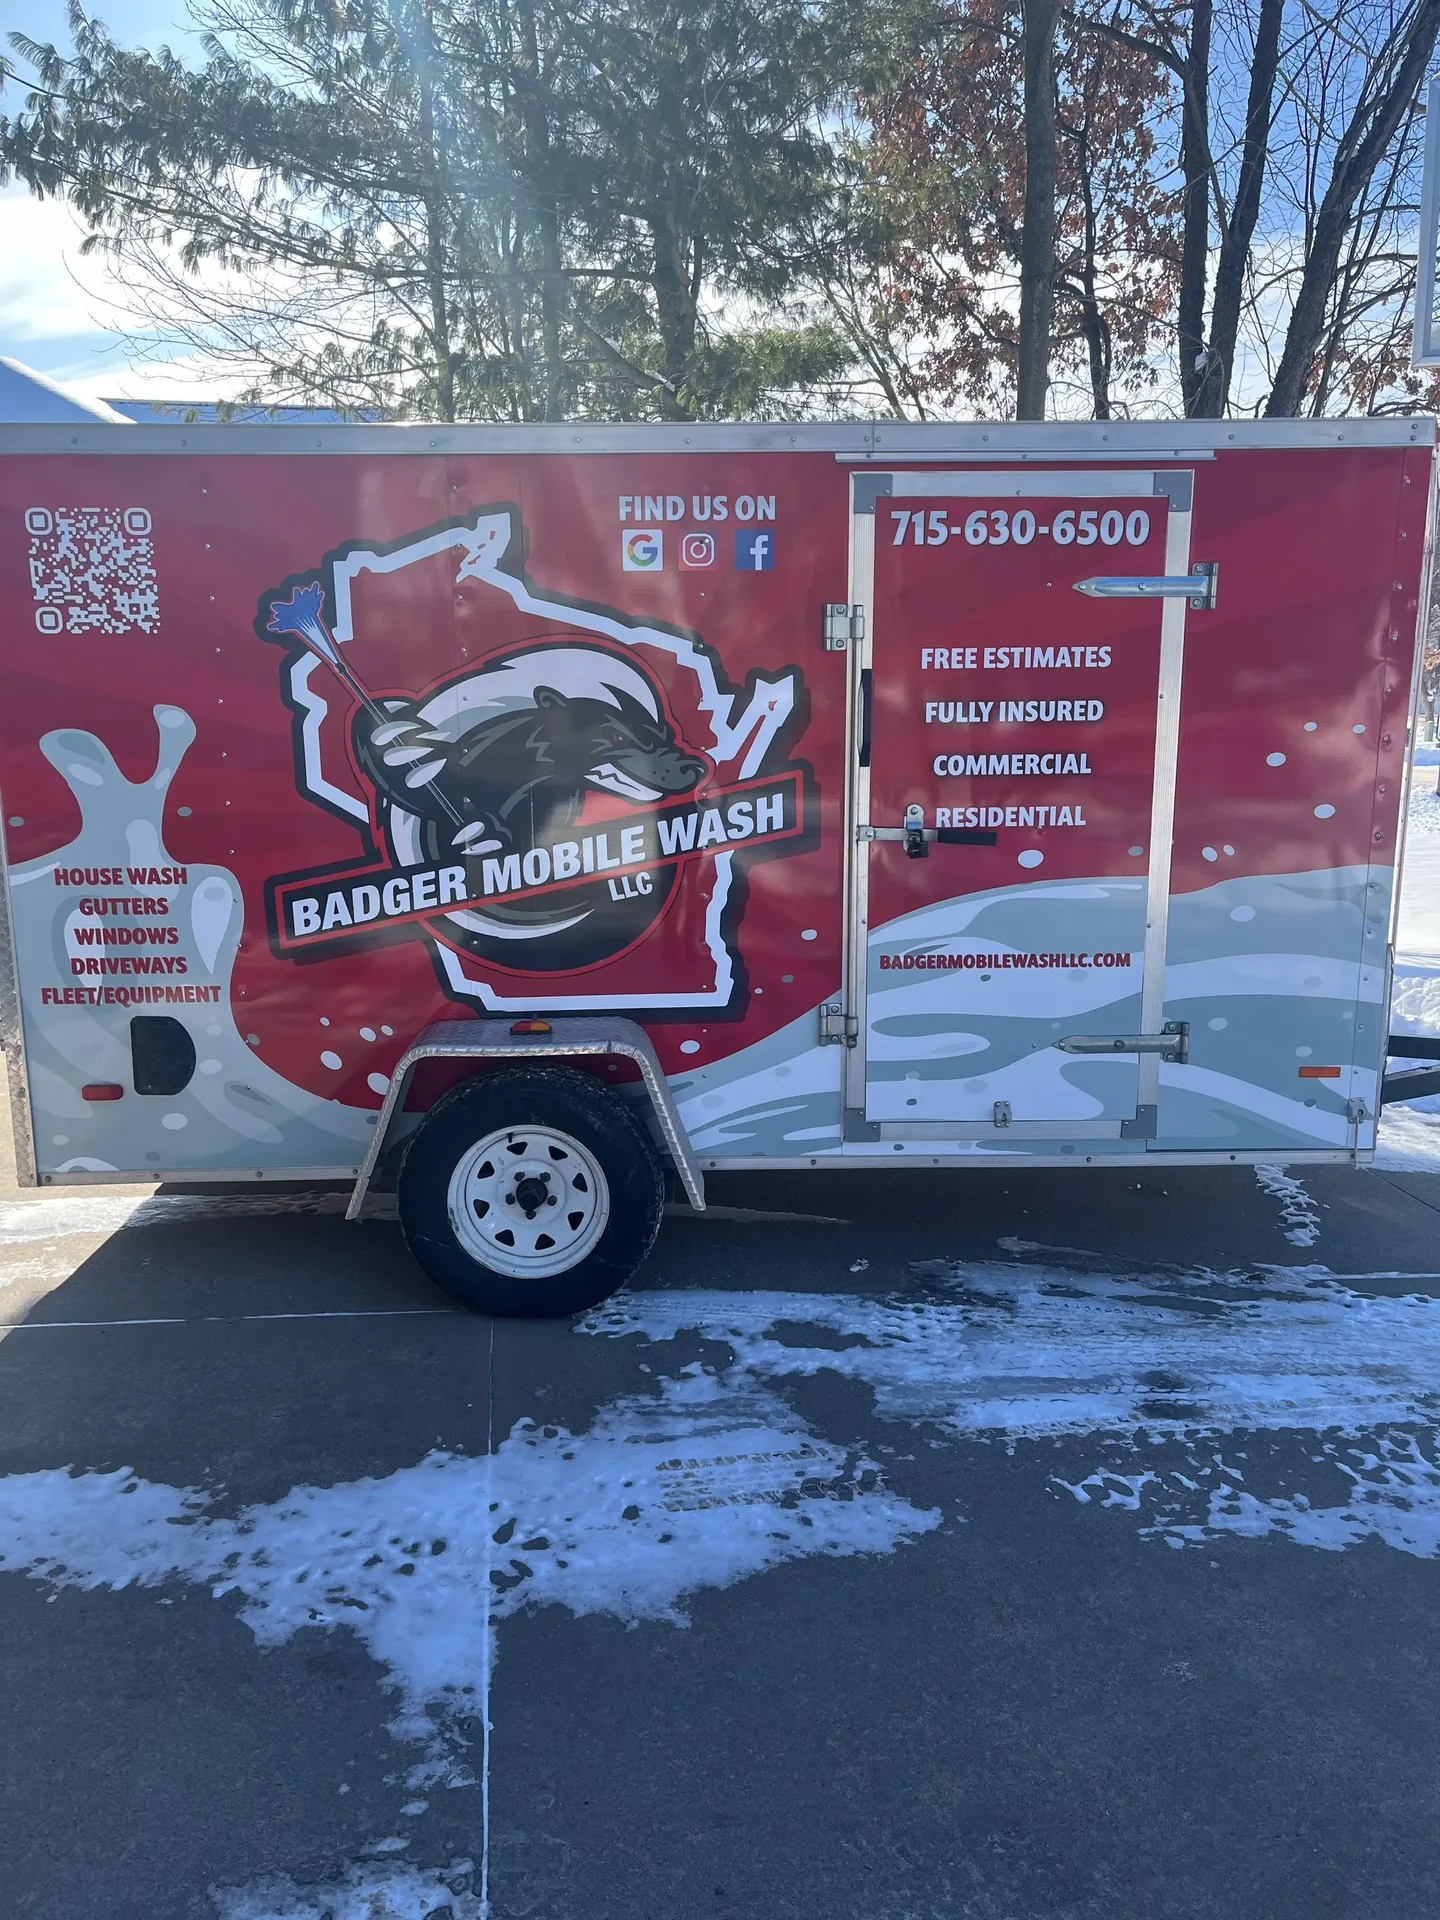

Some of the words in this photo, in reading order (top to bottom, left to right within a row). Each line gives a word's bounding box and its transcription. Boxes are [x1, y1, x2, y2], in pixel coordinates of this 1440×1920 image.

[618, 496, 686, 522] FIND
[692, 495, 728, 521] US
[735, 495, 776, 521] ON
[891, 509, 1151, 546] 715-630-6500
[627, 534, 659, 567] G
[921, 647, 977, 670] FREE
[983, 646, 1112, 669] ESTIMATES
[925, 701, 994, 724] FULLY
[999, 700, 1104, 723] INSURED
[933, 753, 1092, 776] COMMERCIAL
[935, 805, 1087, 829] RESIDENTIAL
[291, 865, 468, 936] BADGER
[482, 825, 646, 895] MOBILE
[657, 792, 785, 856] WASH
[54, 868, 124, 886] HOUSE
[126, 867, 188, 885] WASH
[608, 871, 653, 902] LLC
[79, 897, 169, 916] GUTTERS
[74, 927, 179, 945] WINDOWS
[70, 957, 188, 975] DRIVEWAYS
[880, 953, 1131, 970] BADGERMOBILEWASHLLC.COM
[41, 986, 221, 1007] FLEET/EQUIPMENT
